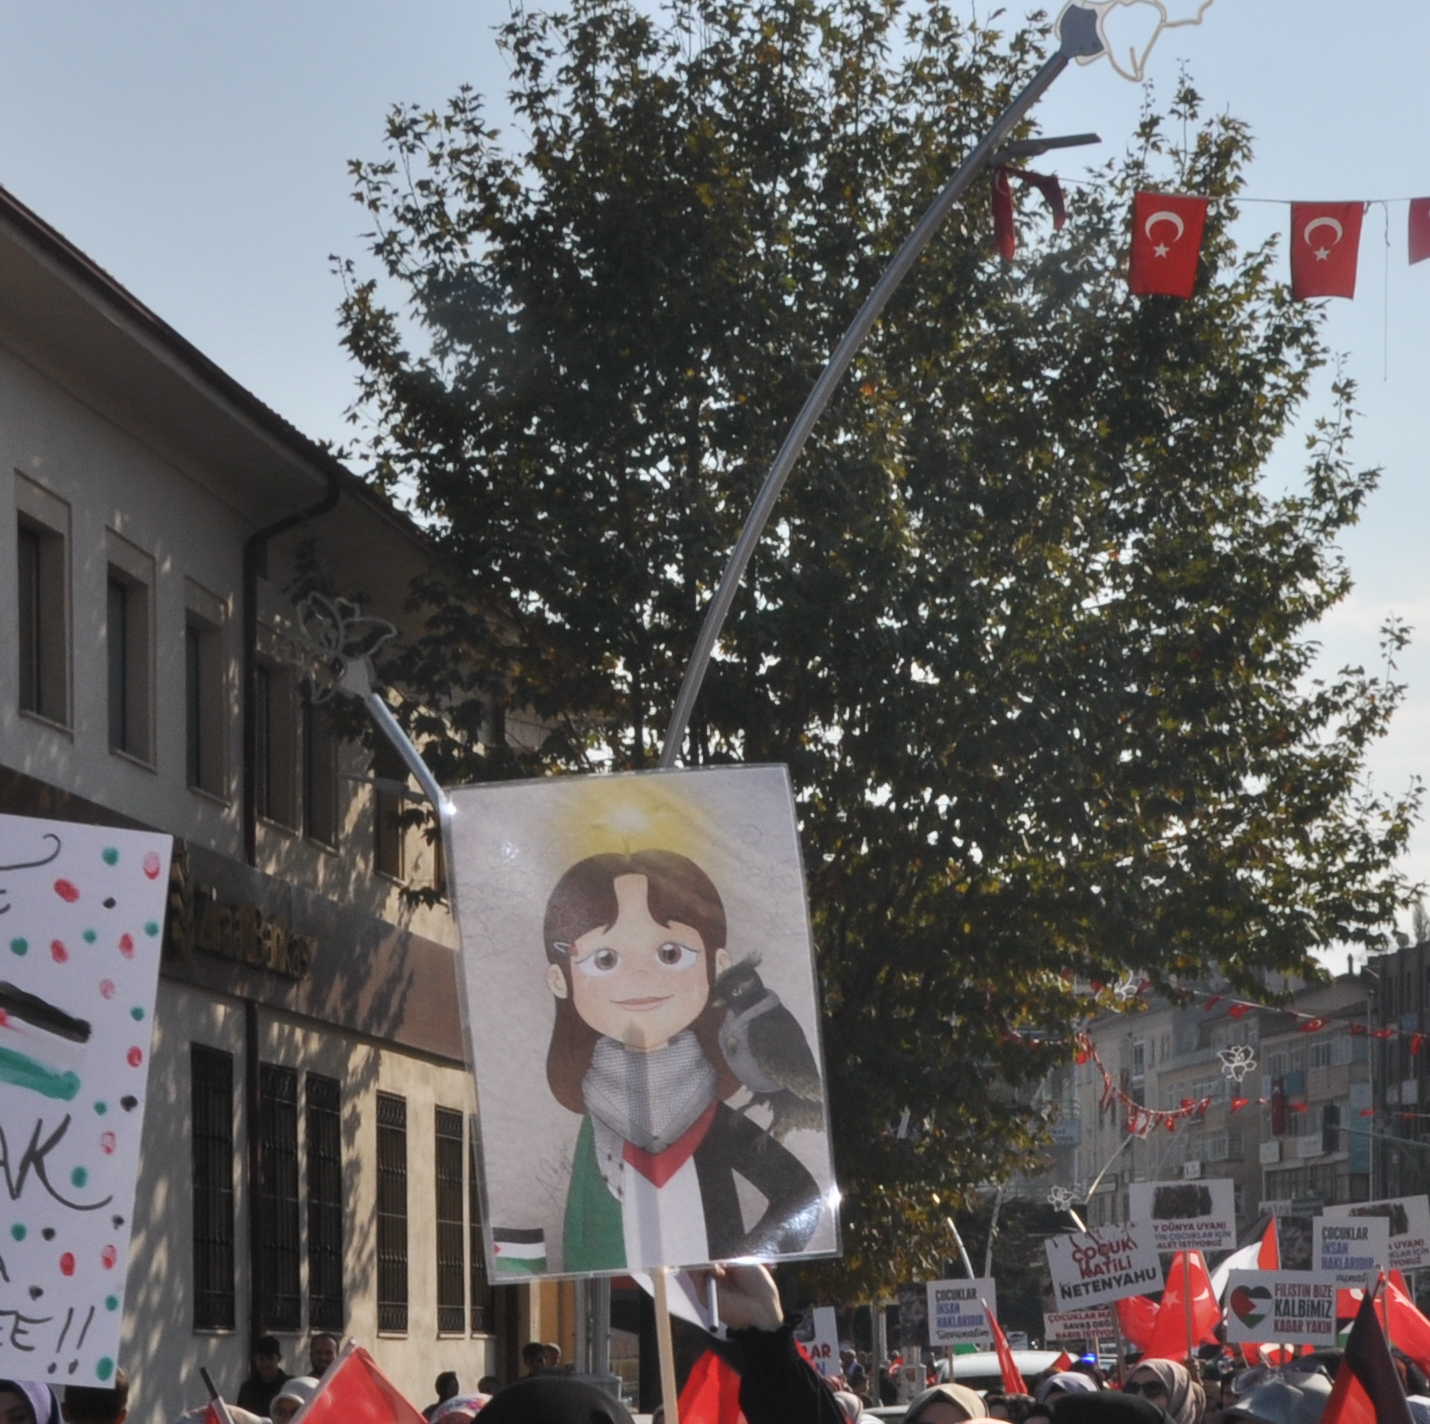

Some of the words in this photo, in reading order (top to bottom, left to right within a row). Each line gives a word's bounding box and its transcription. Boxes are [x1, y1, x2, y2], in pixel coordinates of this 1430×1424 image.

[1162, 1221, 1194, 1231] DÜNYA
[1157, 1241, 1177, 1249] ALET
[1072, 1239, 1134, 1262] ÇOCUK
[1060, 1267, 1156, 1300] NETENYAHU
[1093, 1318, 1110, 1328] DEĞ
